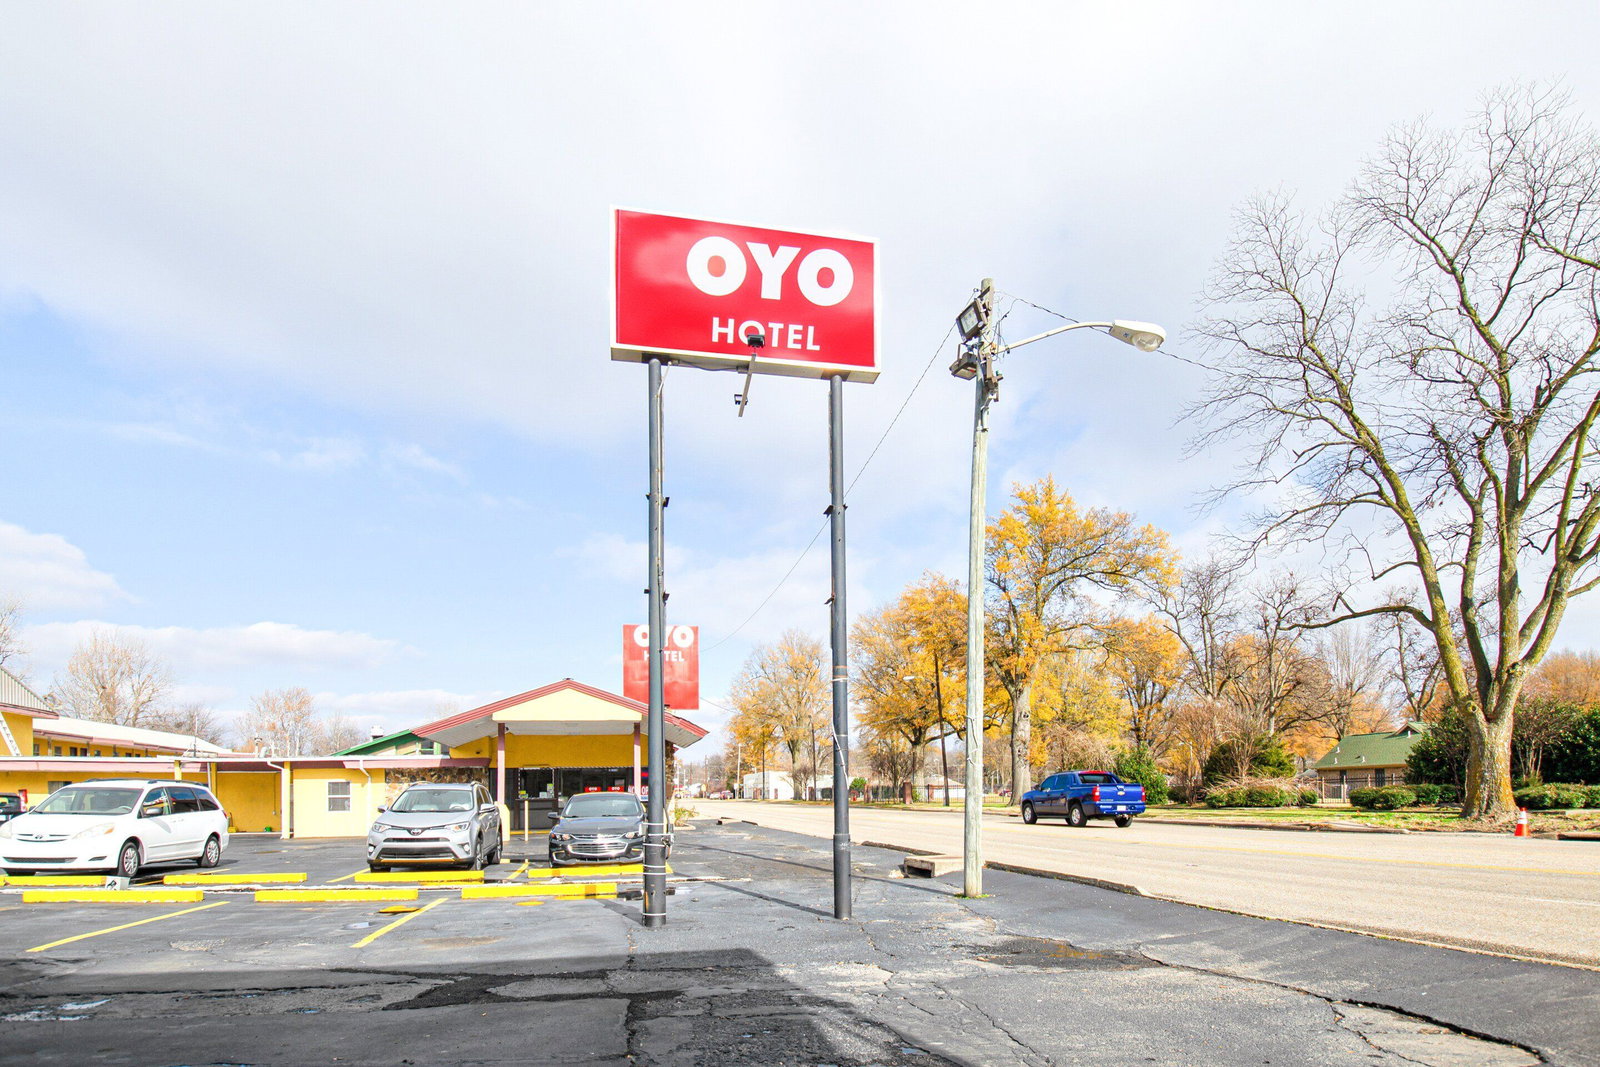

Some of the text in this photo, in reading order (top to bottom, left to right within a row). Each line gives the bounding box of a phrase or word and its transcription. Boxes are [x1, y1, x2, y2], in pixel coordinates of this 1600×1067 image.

[686, 236, 854, 307] OYO
[711, 317, 821, 351] HOTEL
[644, 650, 684, 661] HTEL
